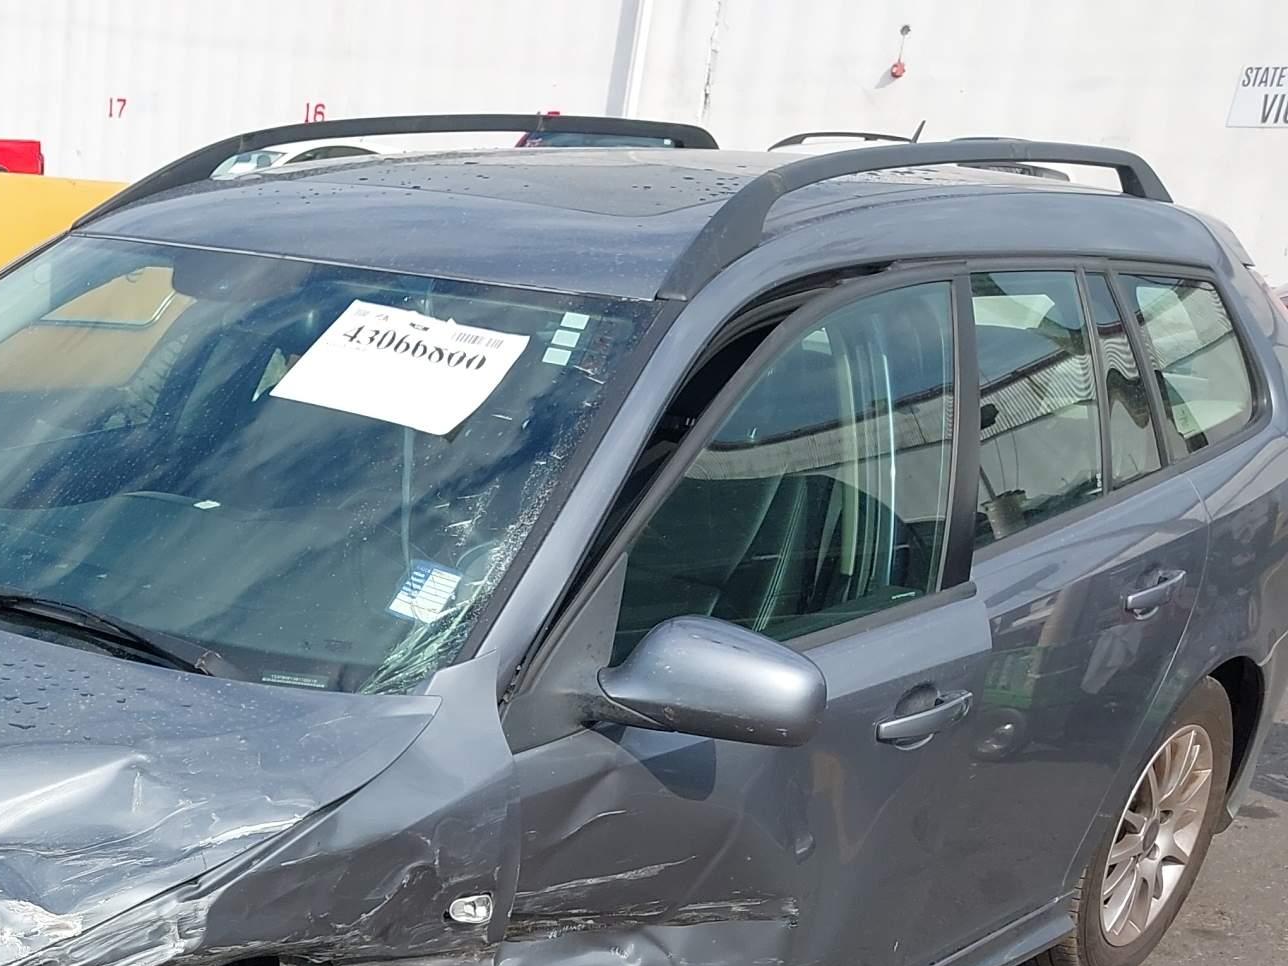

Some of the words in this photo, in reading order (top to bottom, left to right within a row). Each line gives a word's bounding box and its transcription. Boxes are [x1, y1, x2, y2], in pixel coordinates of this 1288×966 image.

[1241, 66, 1288, 87] STATE
[108, 97, 127, 118] 17
[304, 102, 326, 123] 16
[342, 324, 487, 371] 43066800
